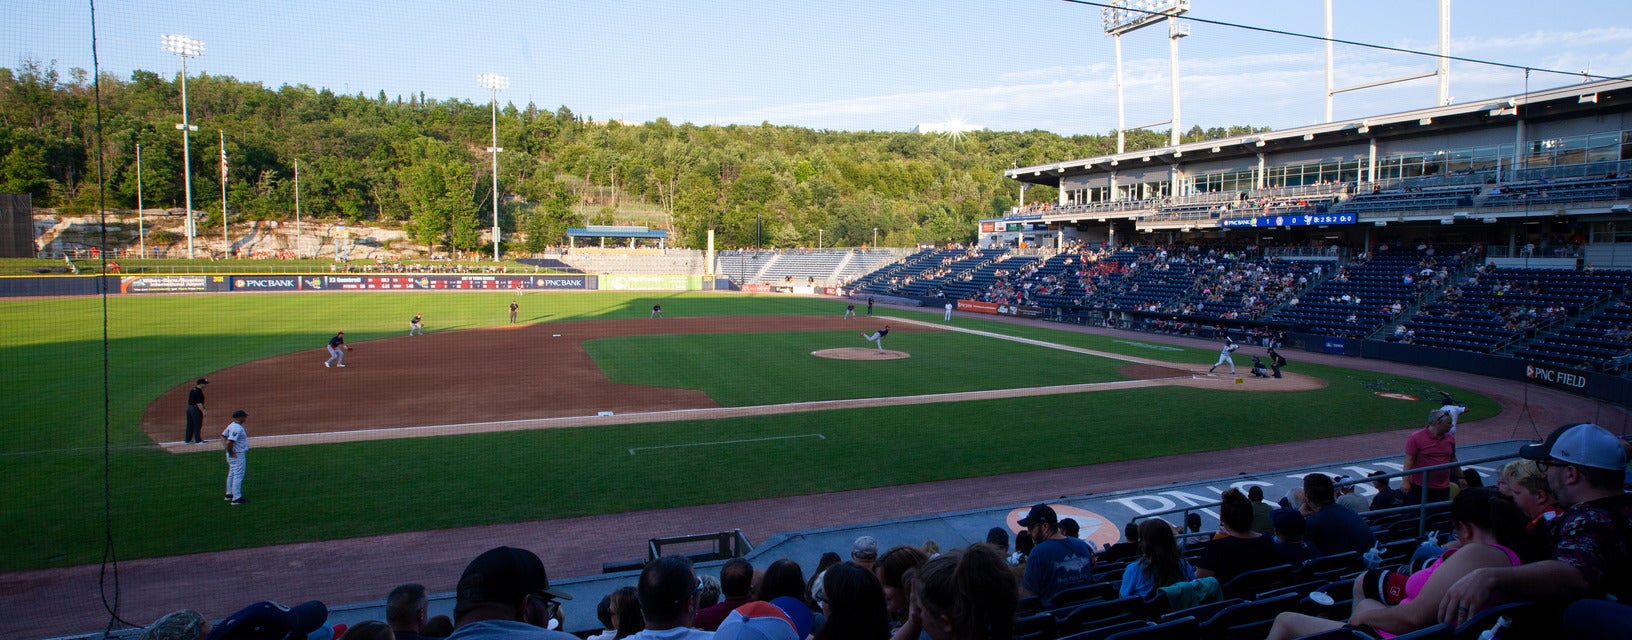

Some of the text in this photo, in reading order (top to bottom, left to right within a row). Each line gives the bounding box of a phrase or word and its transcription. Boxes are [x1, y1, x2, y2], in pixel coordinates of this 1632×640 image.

[247, 279, 295, 287] PNC BANK
[545, 279, 582, 287] PNC BANK
[1535, 367, 1586, 388] PNC FIELD
